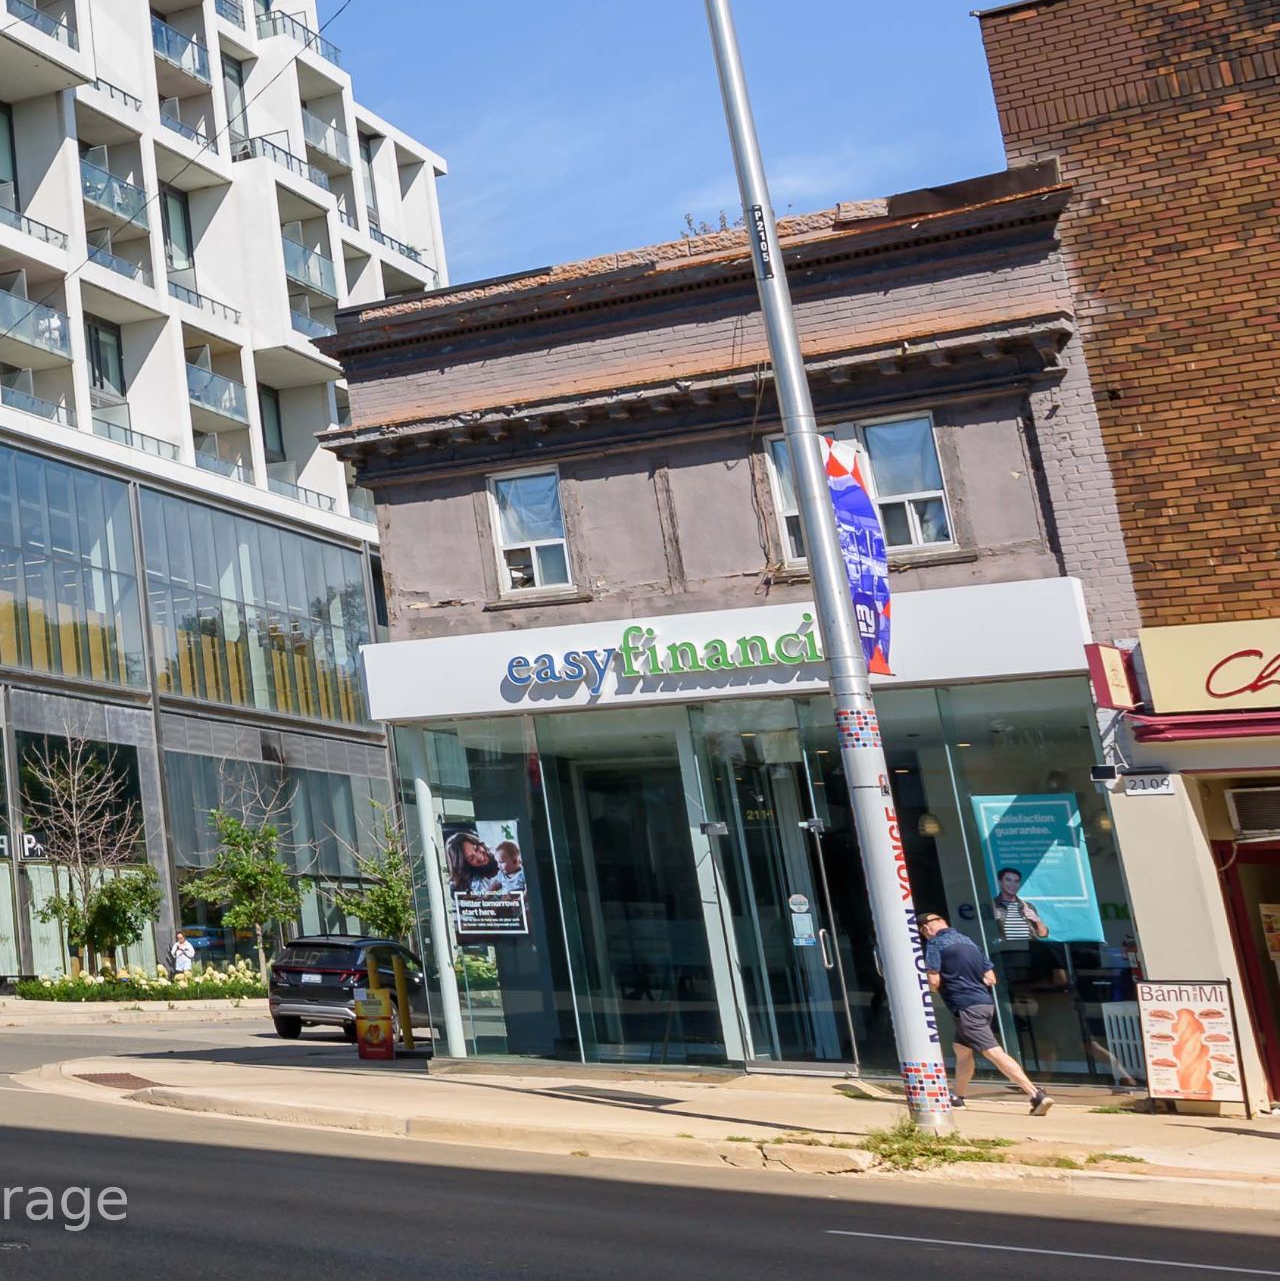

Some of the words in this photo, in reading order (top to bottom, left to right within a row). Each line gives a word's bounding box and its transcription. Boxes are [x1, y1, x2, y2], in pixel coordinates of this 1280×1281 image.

[506, 612, 824, 696] easyfinanci
[1129, 778, 1170, 790] 2109
[992, 813, 1055, 824] Satisfaction
[995, 825, 1052, 837] guarantee.
[23, 834, 36, 856] P
[462, 908, 479, 916] start
[479, 908, 497, 916] here.
[1140, 985, 1191, 1003] Bánh
[1198, 985, 1225, 1003] Mì
